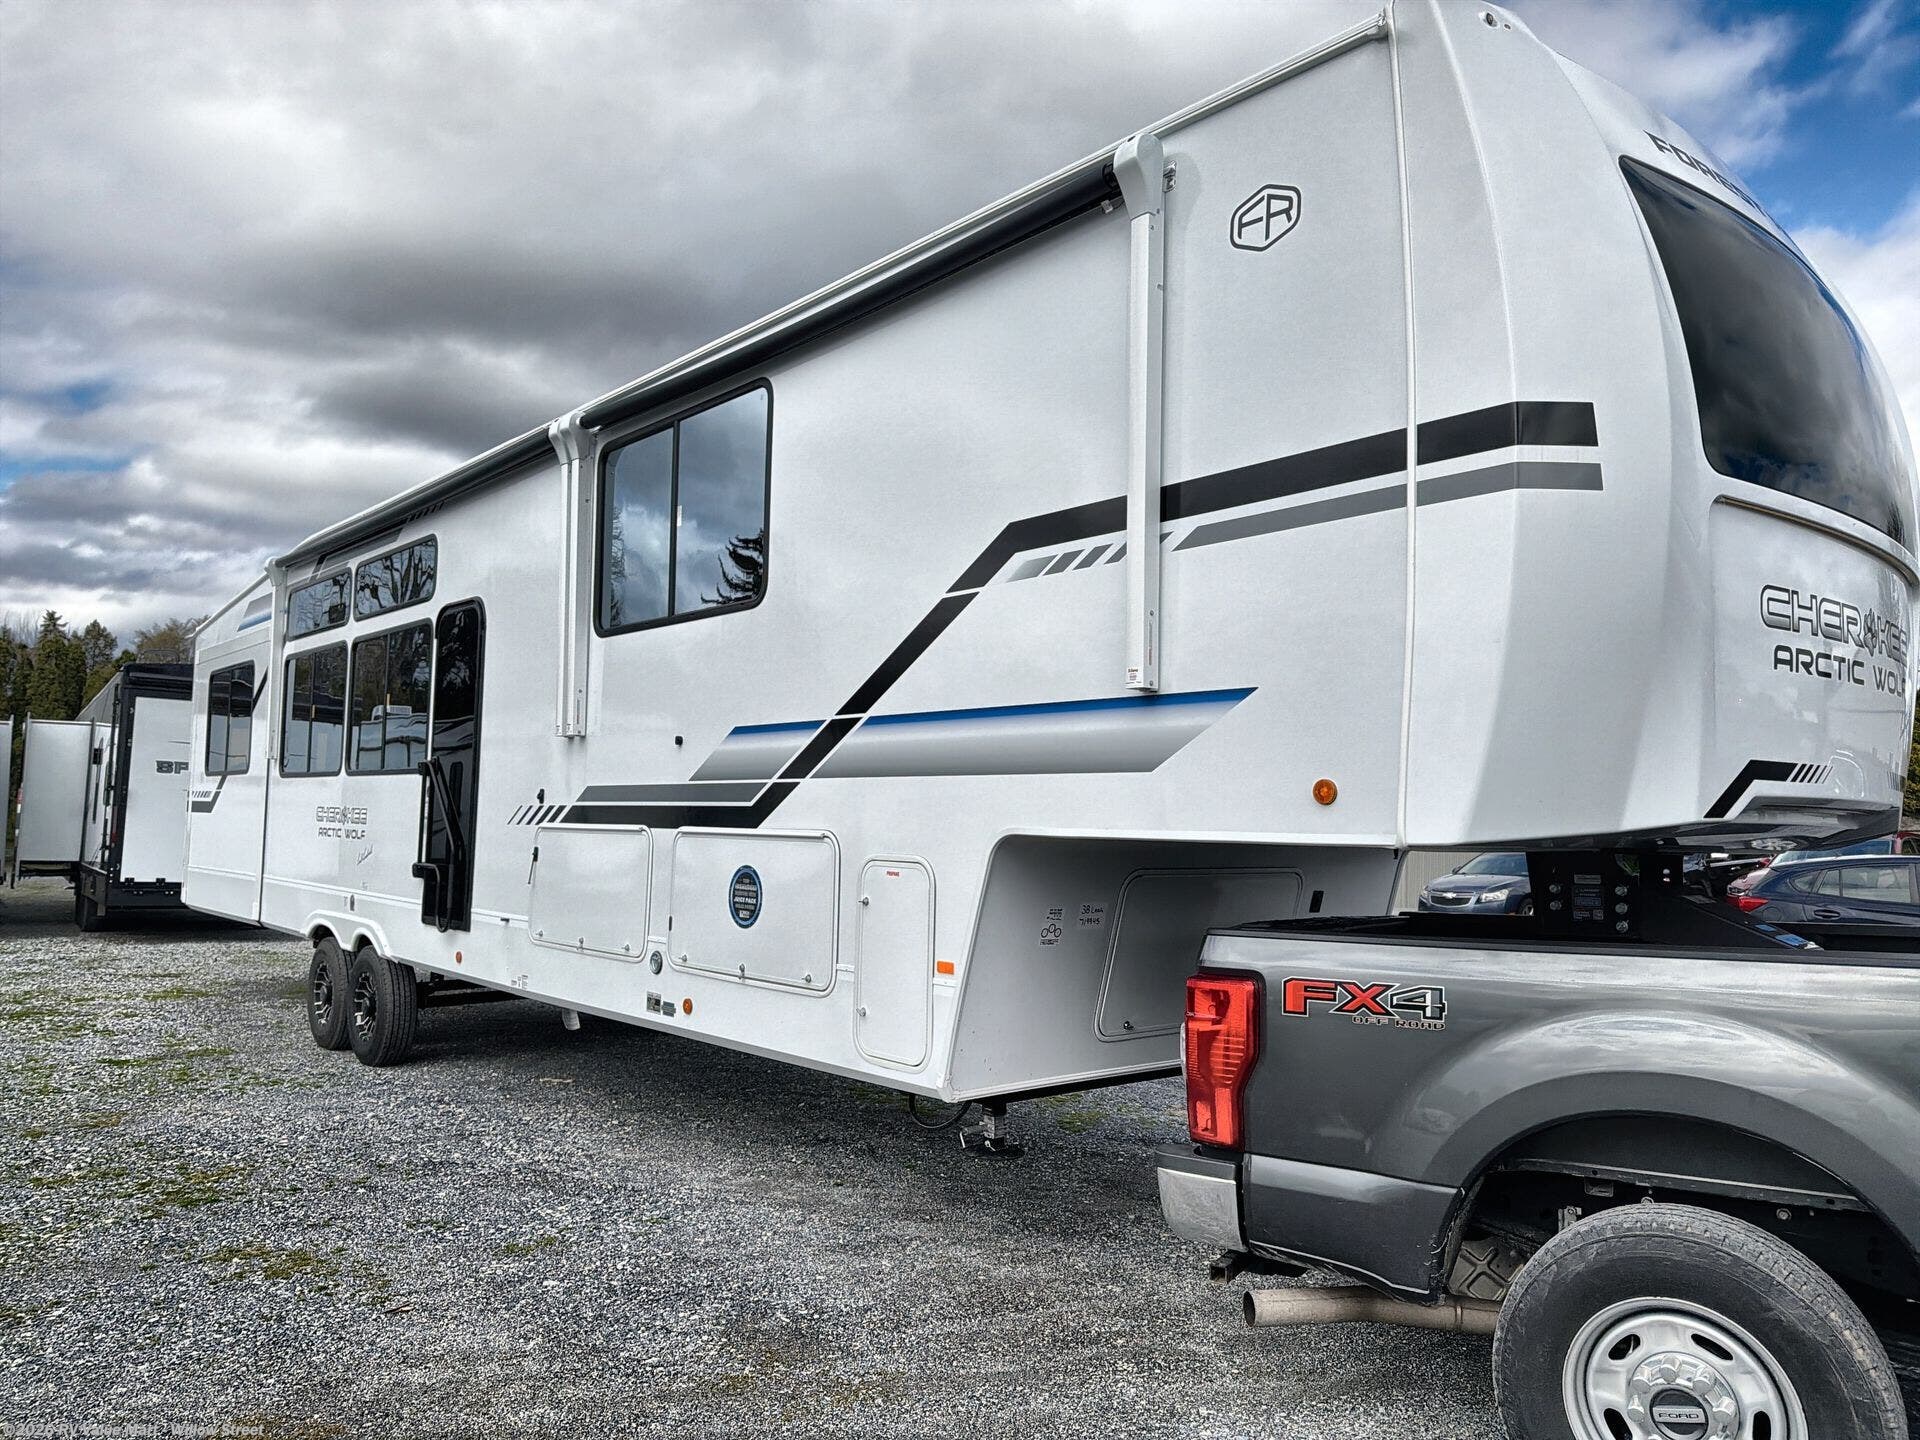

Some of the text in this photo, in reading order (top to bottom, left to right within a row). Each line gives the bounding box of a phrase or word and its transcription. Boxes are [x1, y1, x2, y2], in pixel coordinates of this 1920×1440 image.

[1237, 193, 1294, 242] FR
[1774, 644, 1865, 686] ARCTIC
[318, 827, 366, 840] ARCTIC WOLF
[1282, 976, 1447, 1022] FX4
[1352, 1016, 1446, 1031] OFF ROAD
